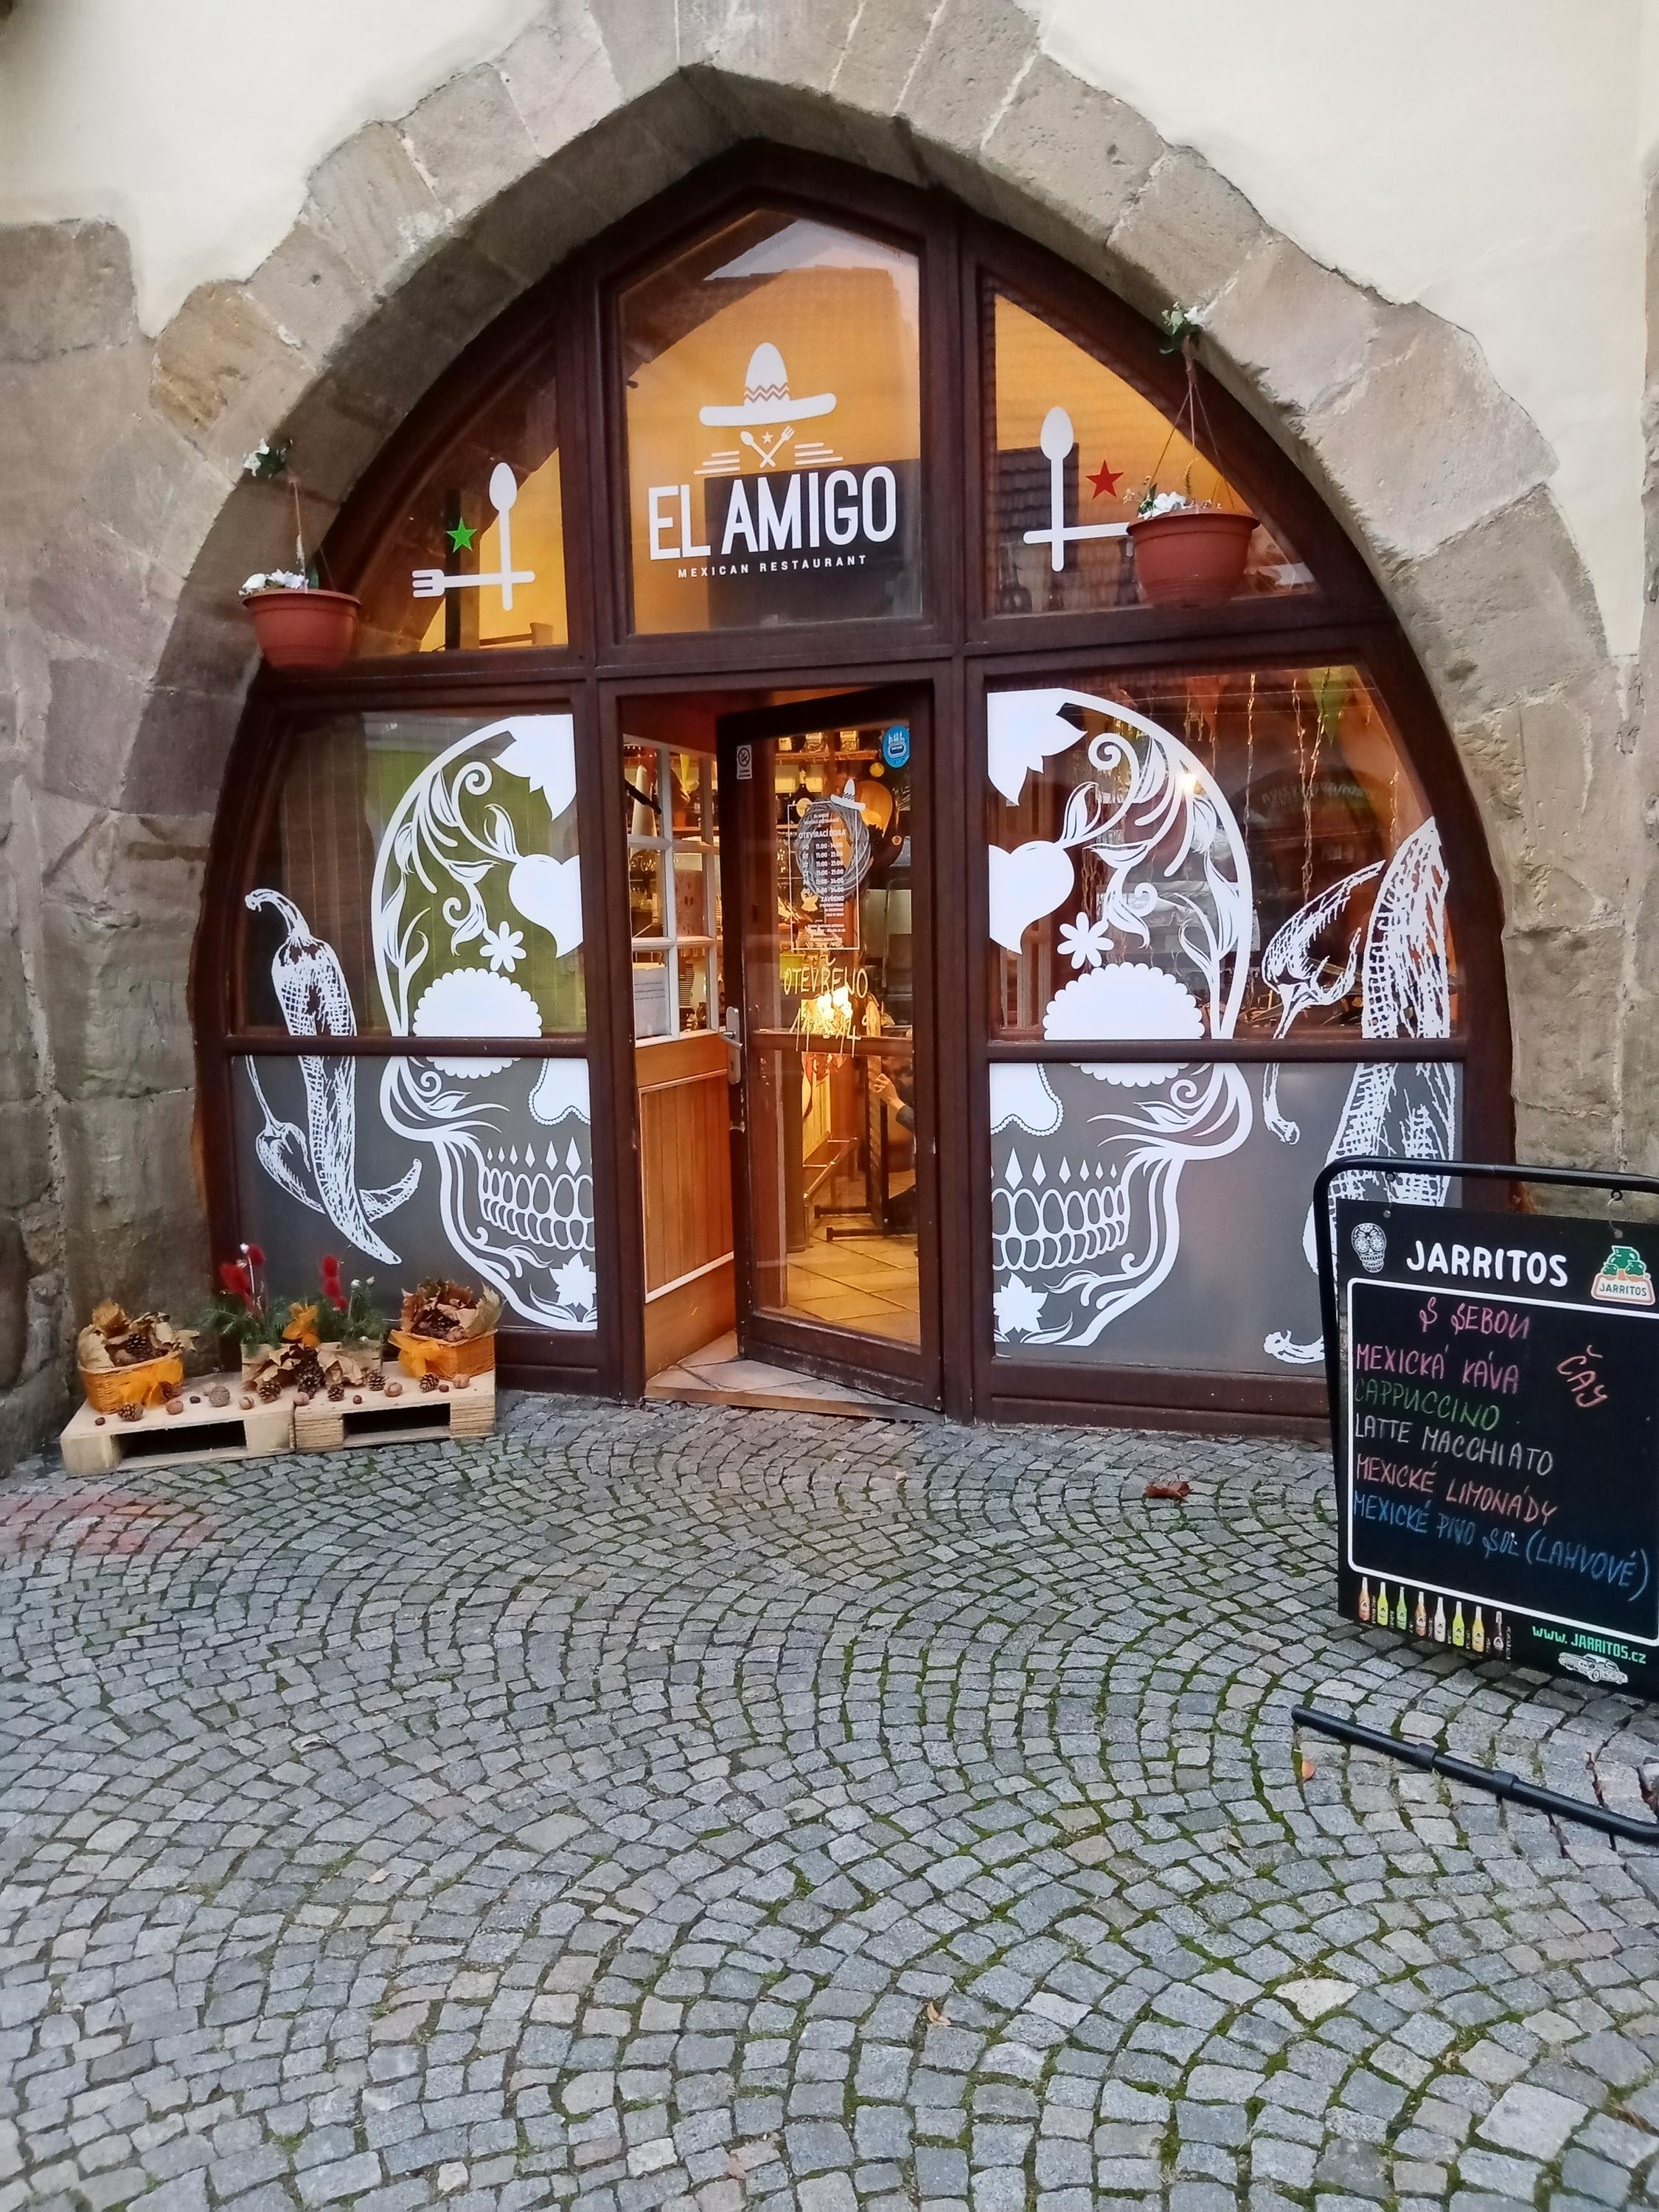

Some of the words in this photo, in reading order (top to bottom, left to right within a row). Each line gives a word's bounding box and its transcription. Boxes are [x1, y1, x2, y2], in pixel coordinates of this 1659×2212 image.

[647, 484, 711, 560] EL
[720, 466, 897, 554] AMIGO
[678, 563, 749, 579] MEXICAN
[759, 554, 866, 573] RESTAURANT
[799, 829, 829, 838] OTEVÍRACÍ
[1406, 1240, 1568, 1287] JARRITOS
[1599, 1282, 1647, 1296] JARRITOS
[1356, 1343, 1449, 1380] MEXICKÁ
[1462, 1351, 1520, 1394] KÁVA
[1354, 1378, 1500, 1431] CAPPUCCINO
[1355, 1413, 1413, 1443] LATTE
[1422, 1426, 1554, 1475] MACCHIATO
[1354, 1489, 1433, 1533] MEXICKÉ
[1357, 1453, 1439, 1493] MEXICKÉ
[1445, 1478, 1558, 1526] LIMONÁDY
